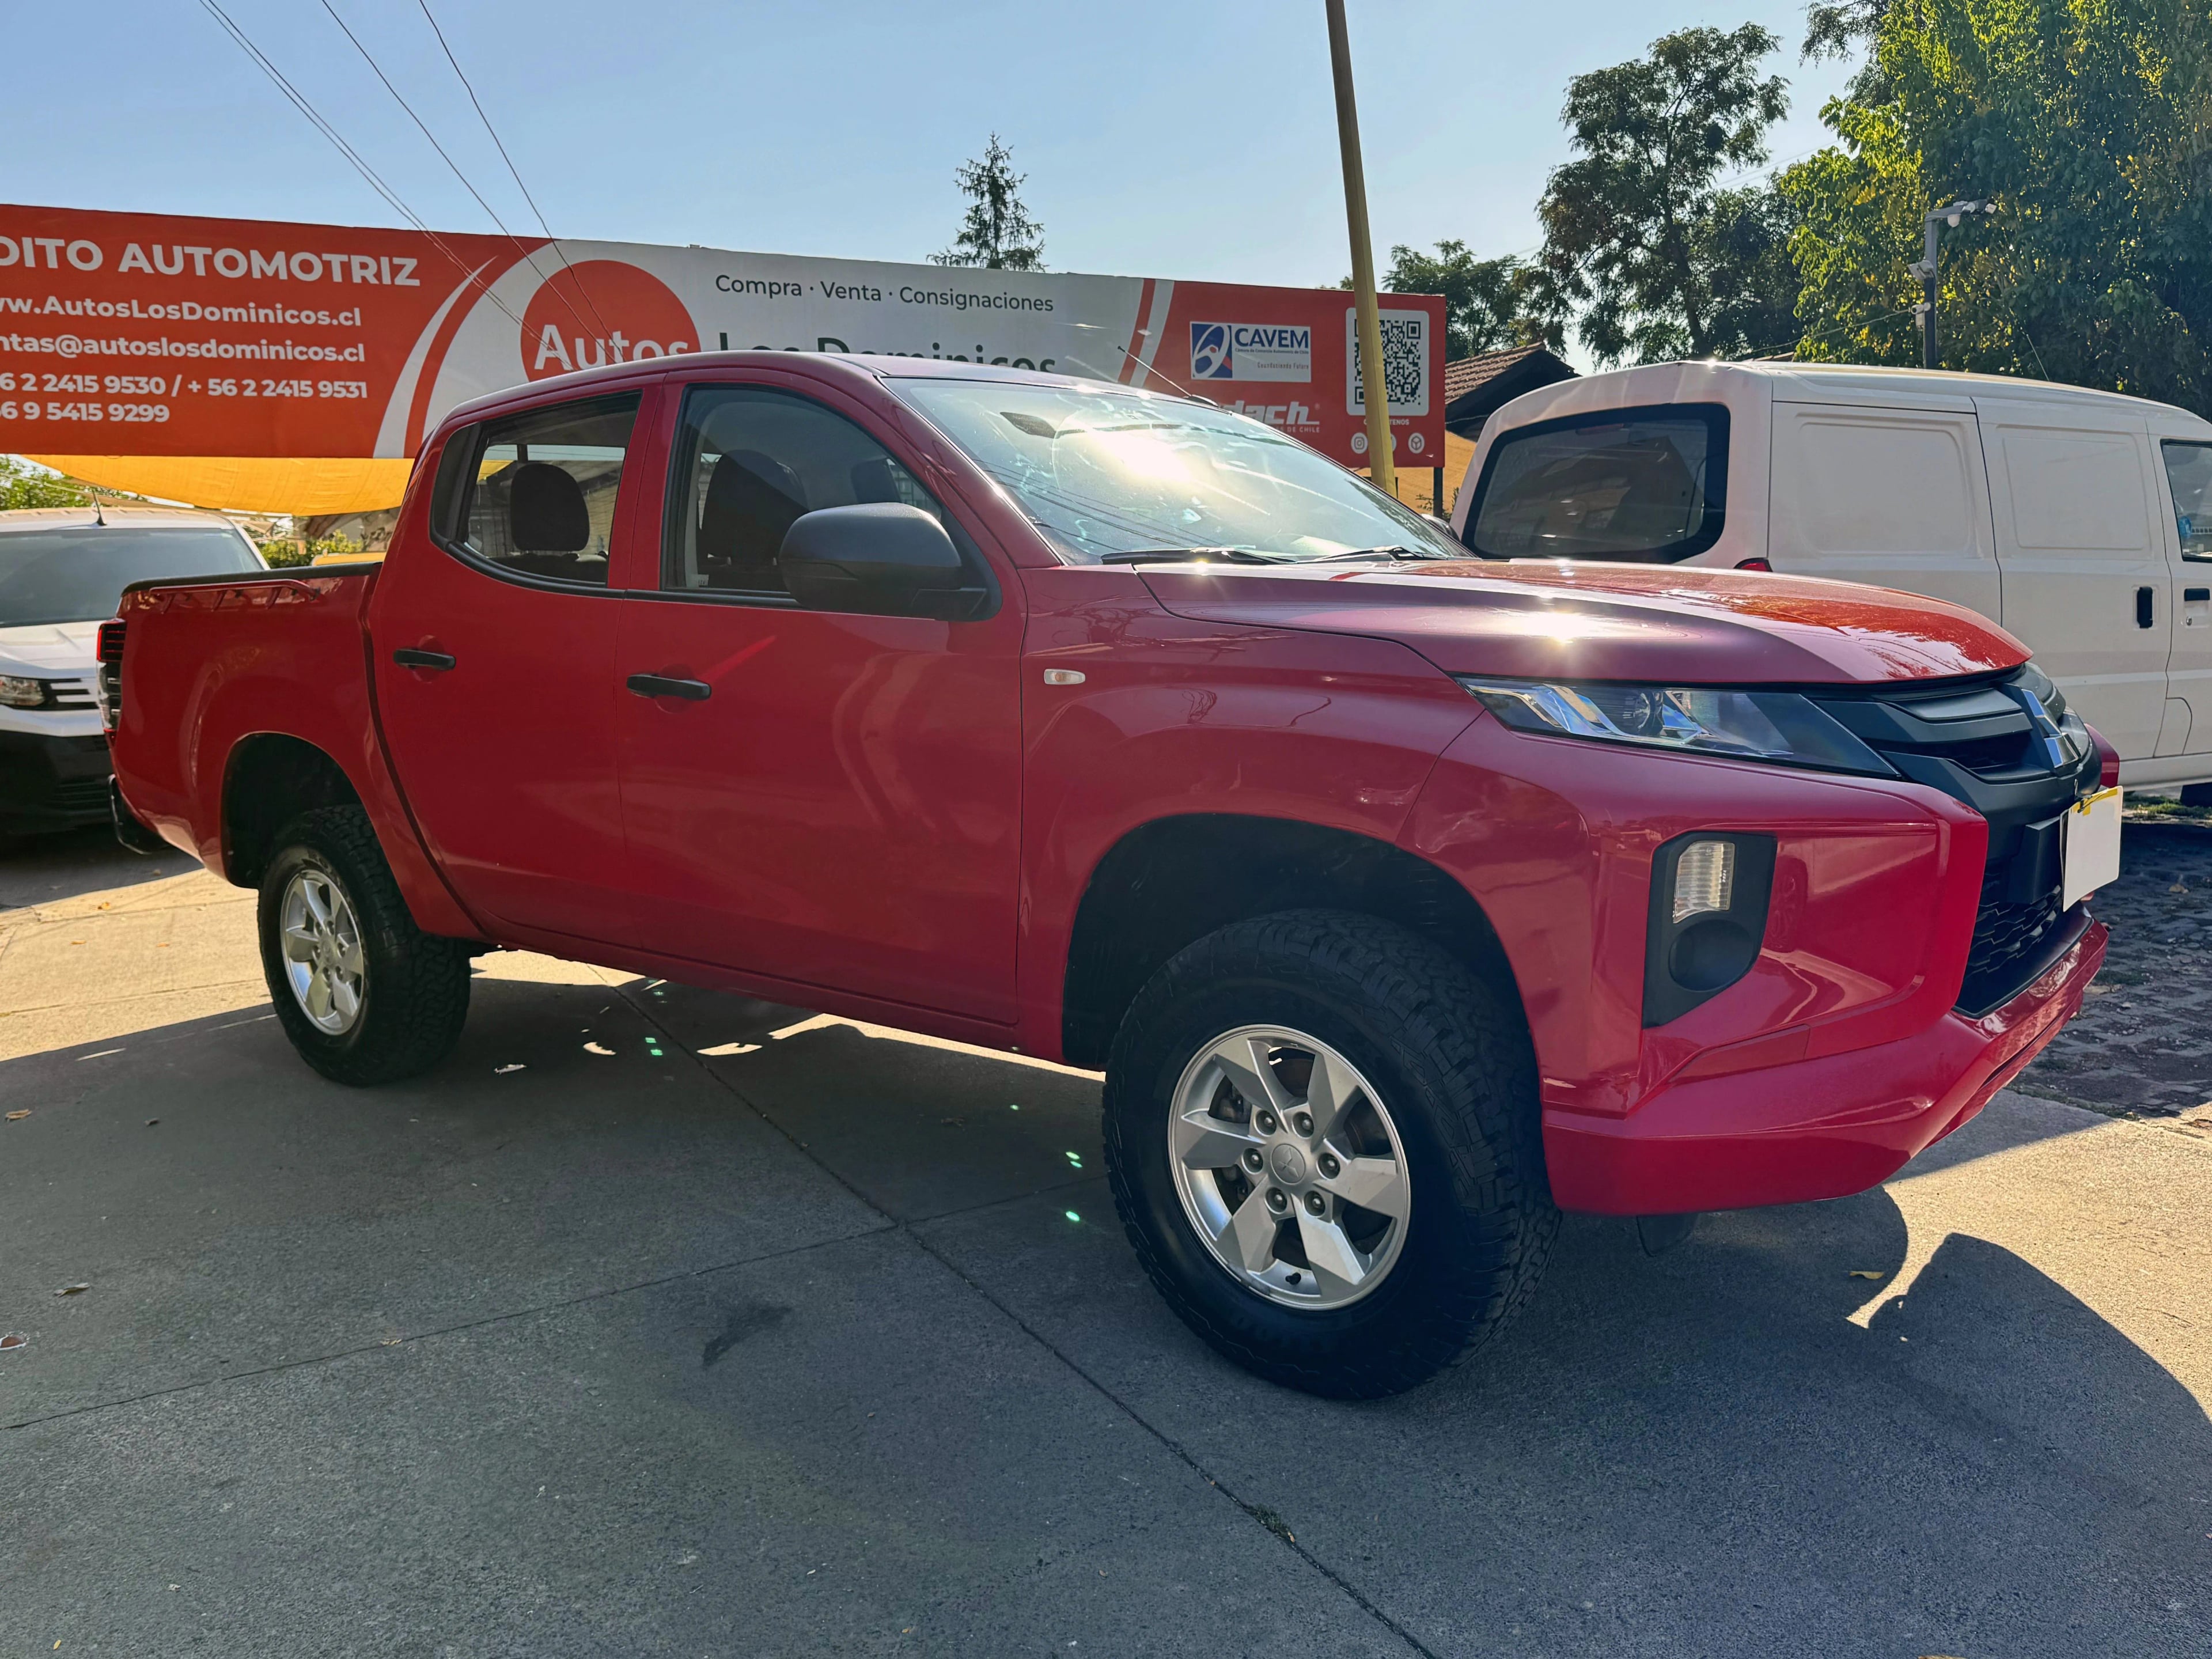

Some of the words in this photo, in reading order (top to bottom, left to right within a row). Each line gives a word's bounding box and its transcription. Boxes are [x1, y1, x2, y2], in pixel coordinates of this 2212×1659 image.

[0, 236, 104, 271] DITO
[118, 243, 421, 286] AUTOMOTRIZ
[715, 274, 802, 298] Compra
[820, 281, 882, 302] Venta
[899, 286, 1054, 312] Consignaciones
[0, 296, 361, 327] w.AutosLosDominicos.cl
[1234, 328, 1309, 349] CAVEM
[20, 373, 38, 392] 2
[41, 374, 100, 393] 2415
[104, 376, 166, 395] 9530
[171, 374, 182, 397] /
[208, 378, 238, 396] 56
[241, 379, 258, 396] 2
[261, 380, 313, 397] 2415
[317, 381, 368, 399] 9531
[0, 401, 18, 419] 6
[22, 402, 41, 420] 9
[46, 402, 104, 421] 5415
[108, 403, 171, 423] 9299
